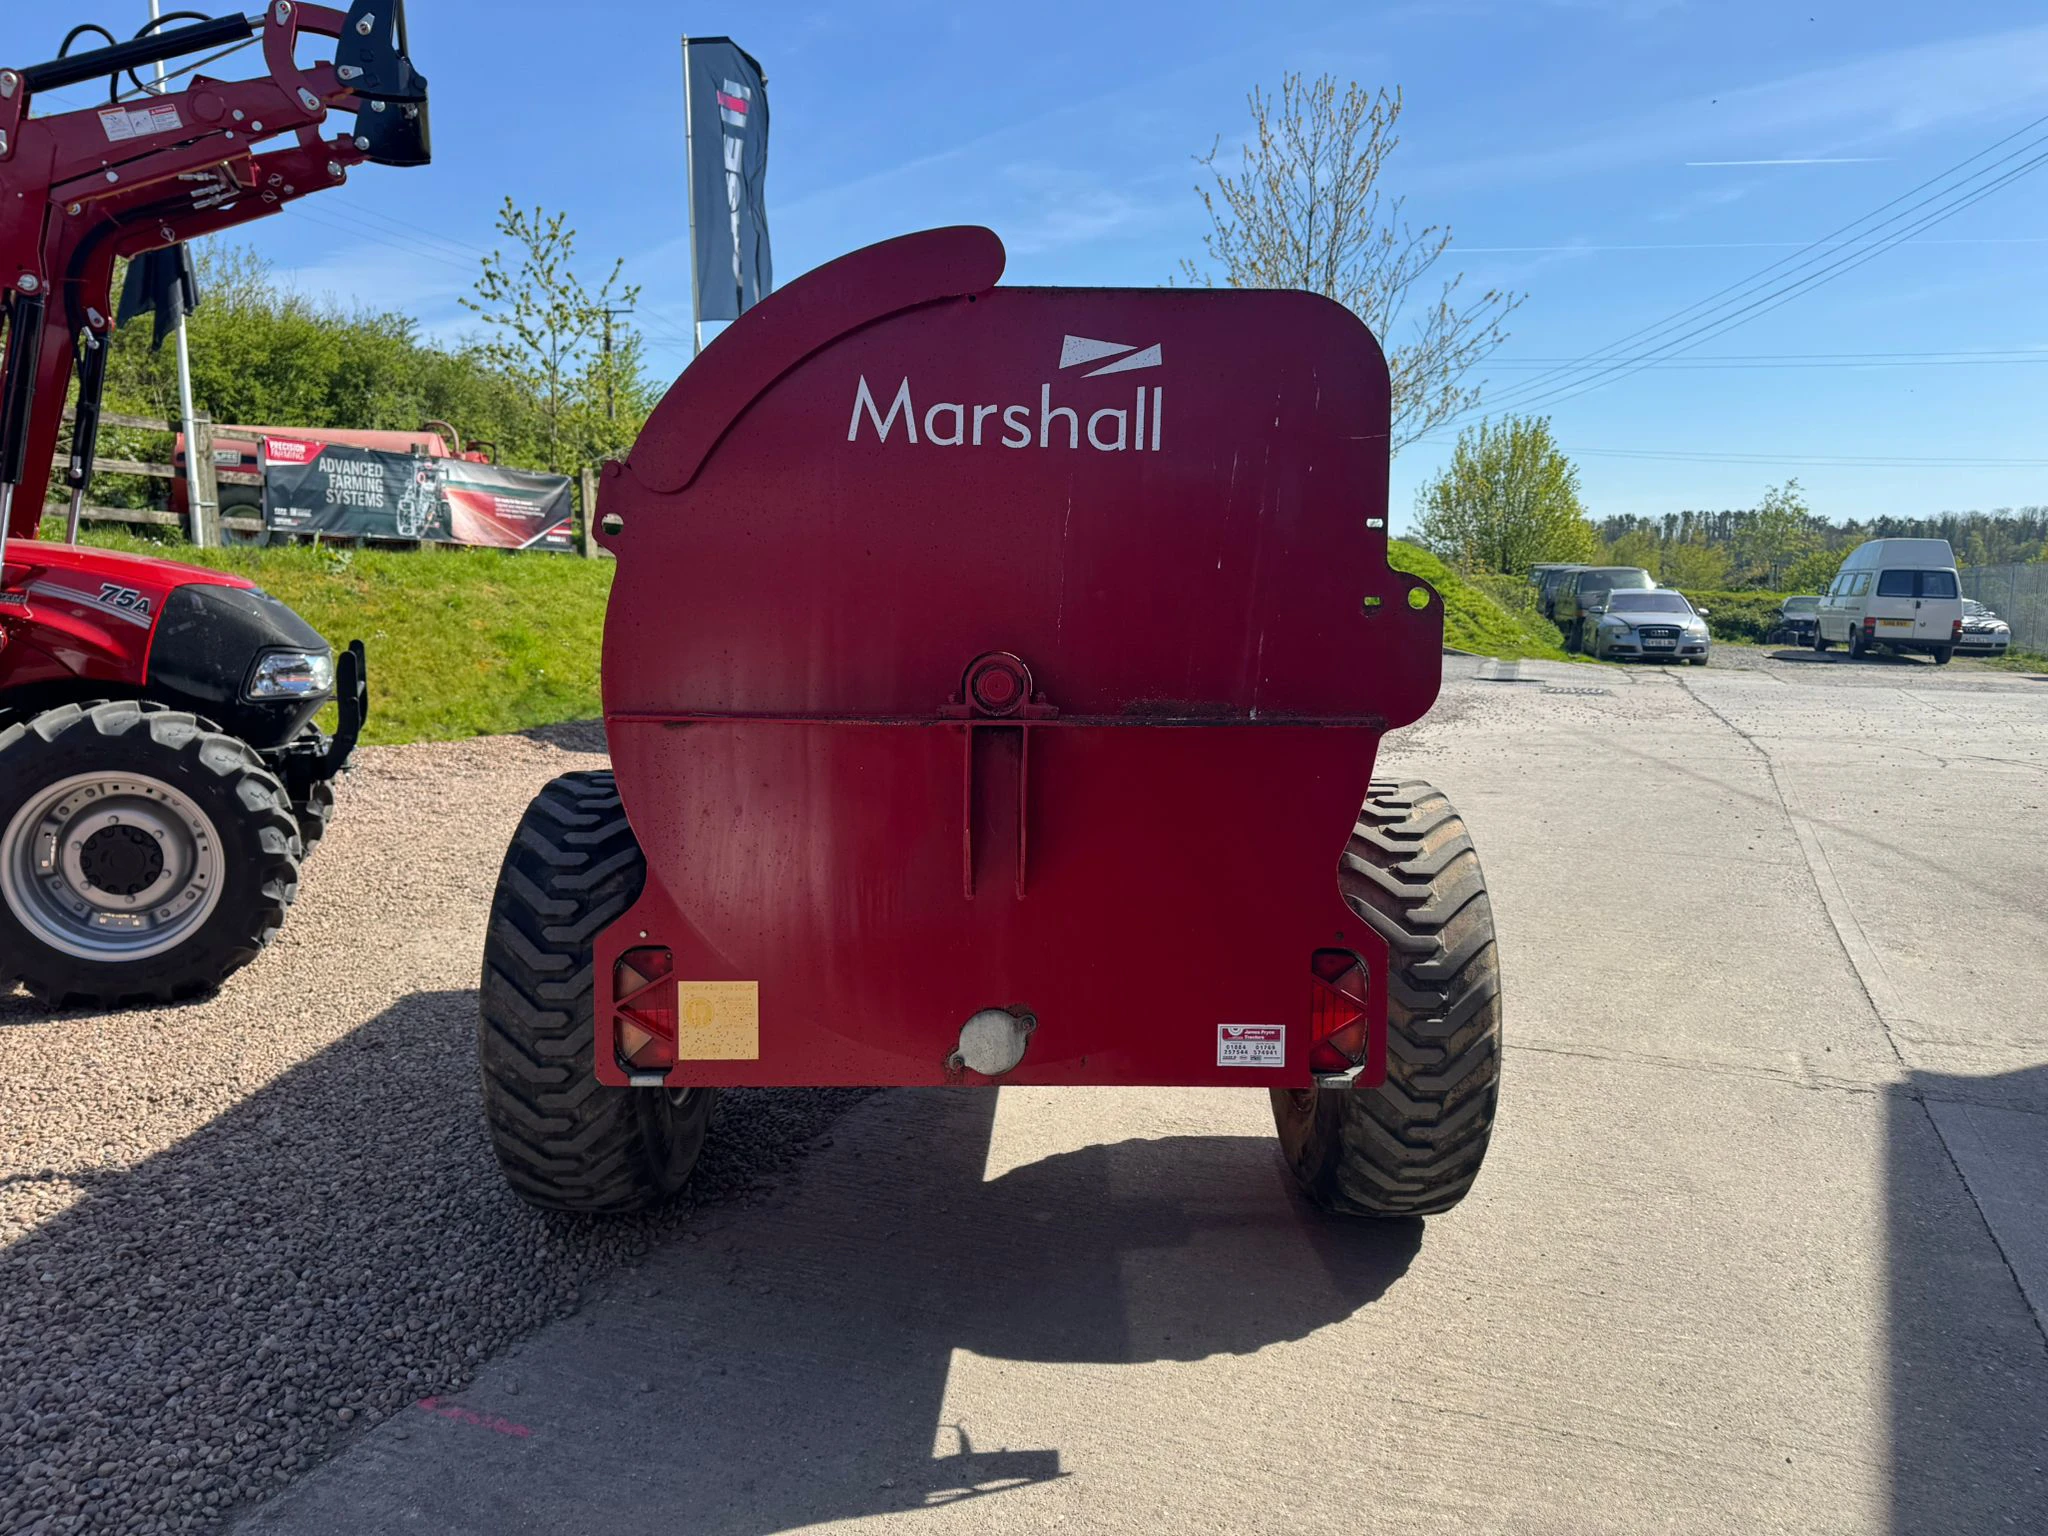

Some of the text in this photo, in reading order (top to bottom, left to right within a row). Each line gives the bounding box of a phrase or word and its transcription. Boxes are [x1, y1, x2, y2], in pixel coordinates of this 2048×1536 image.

[847, 374, 1163, 451] Marshall
[269, 440, 306, 453] PRECISION
[319, 457, 384, 478] ADVANCED
[328, 474, 384, 493] FARMING
[325, 489, 384, 508] SYSTEMS
[97, 582, 152, 615] 75A
